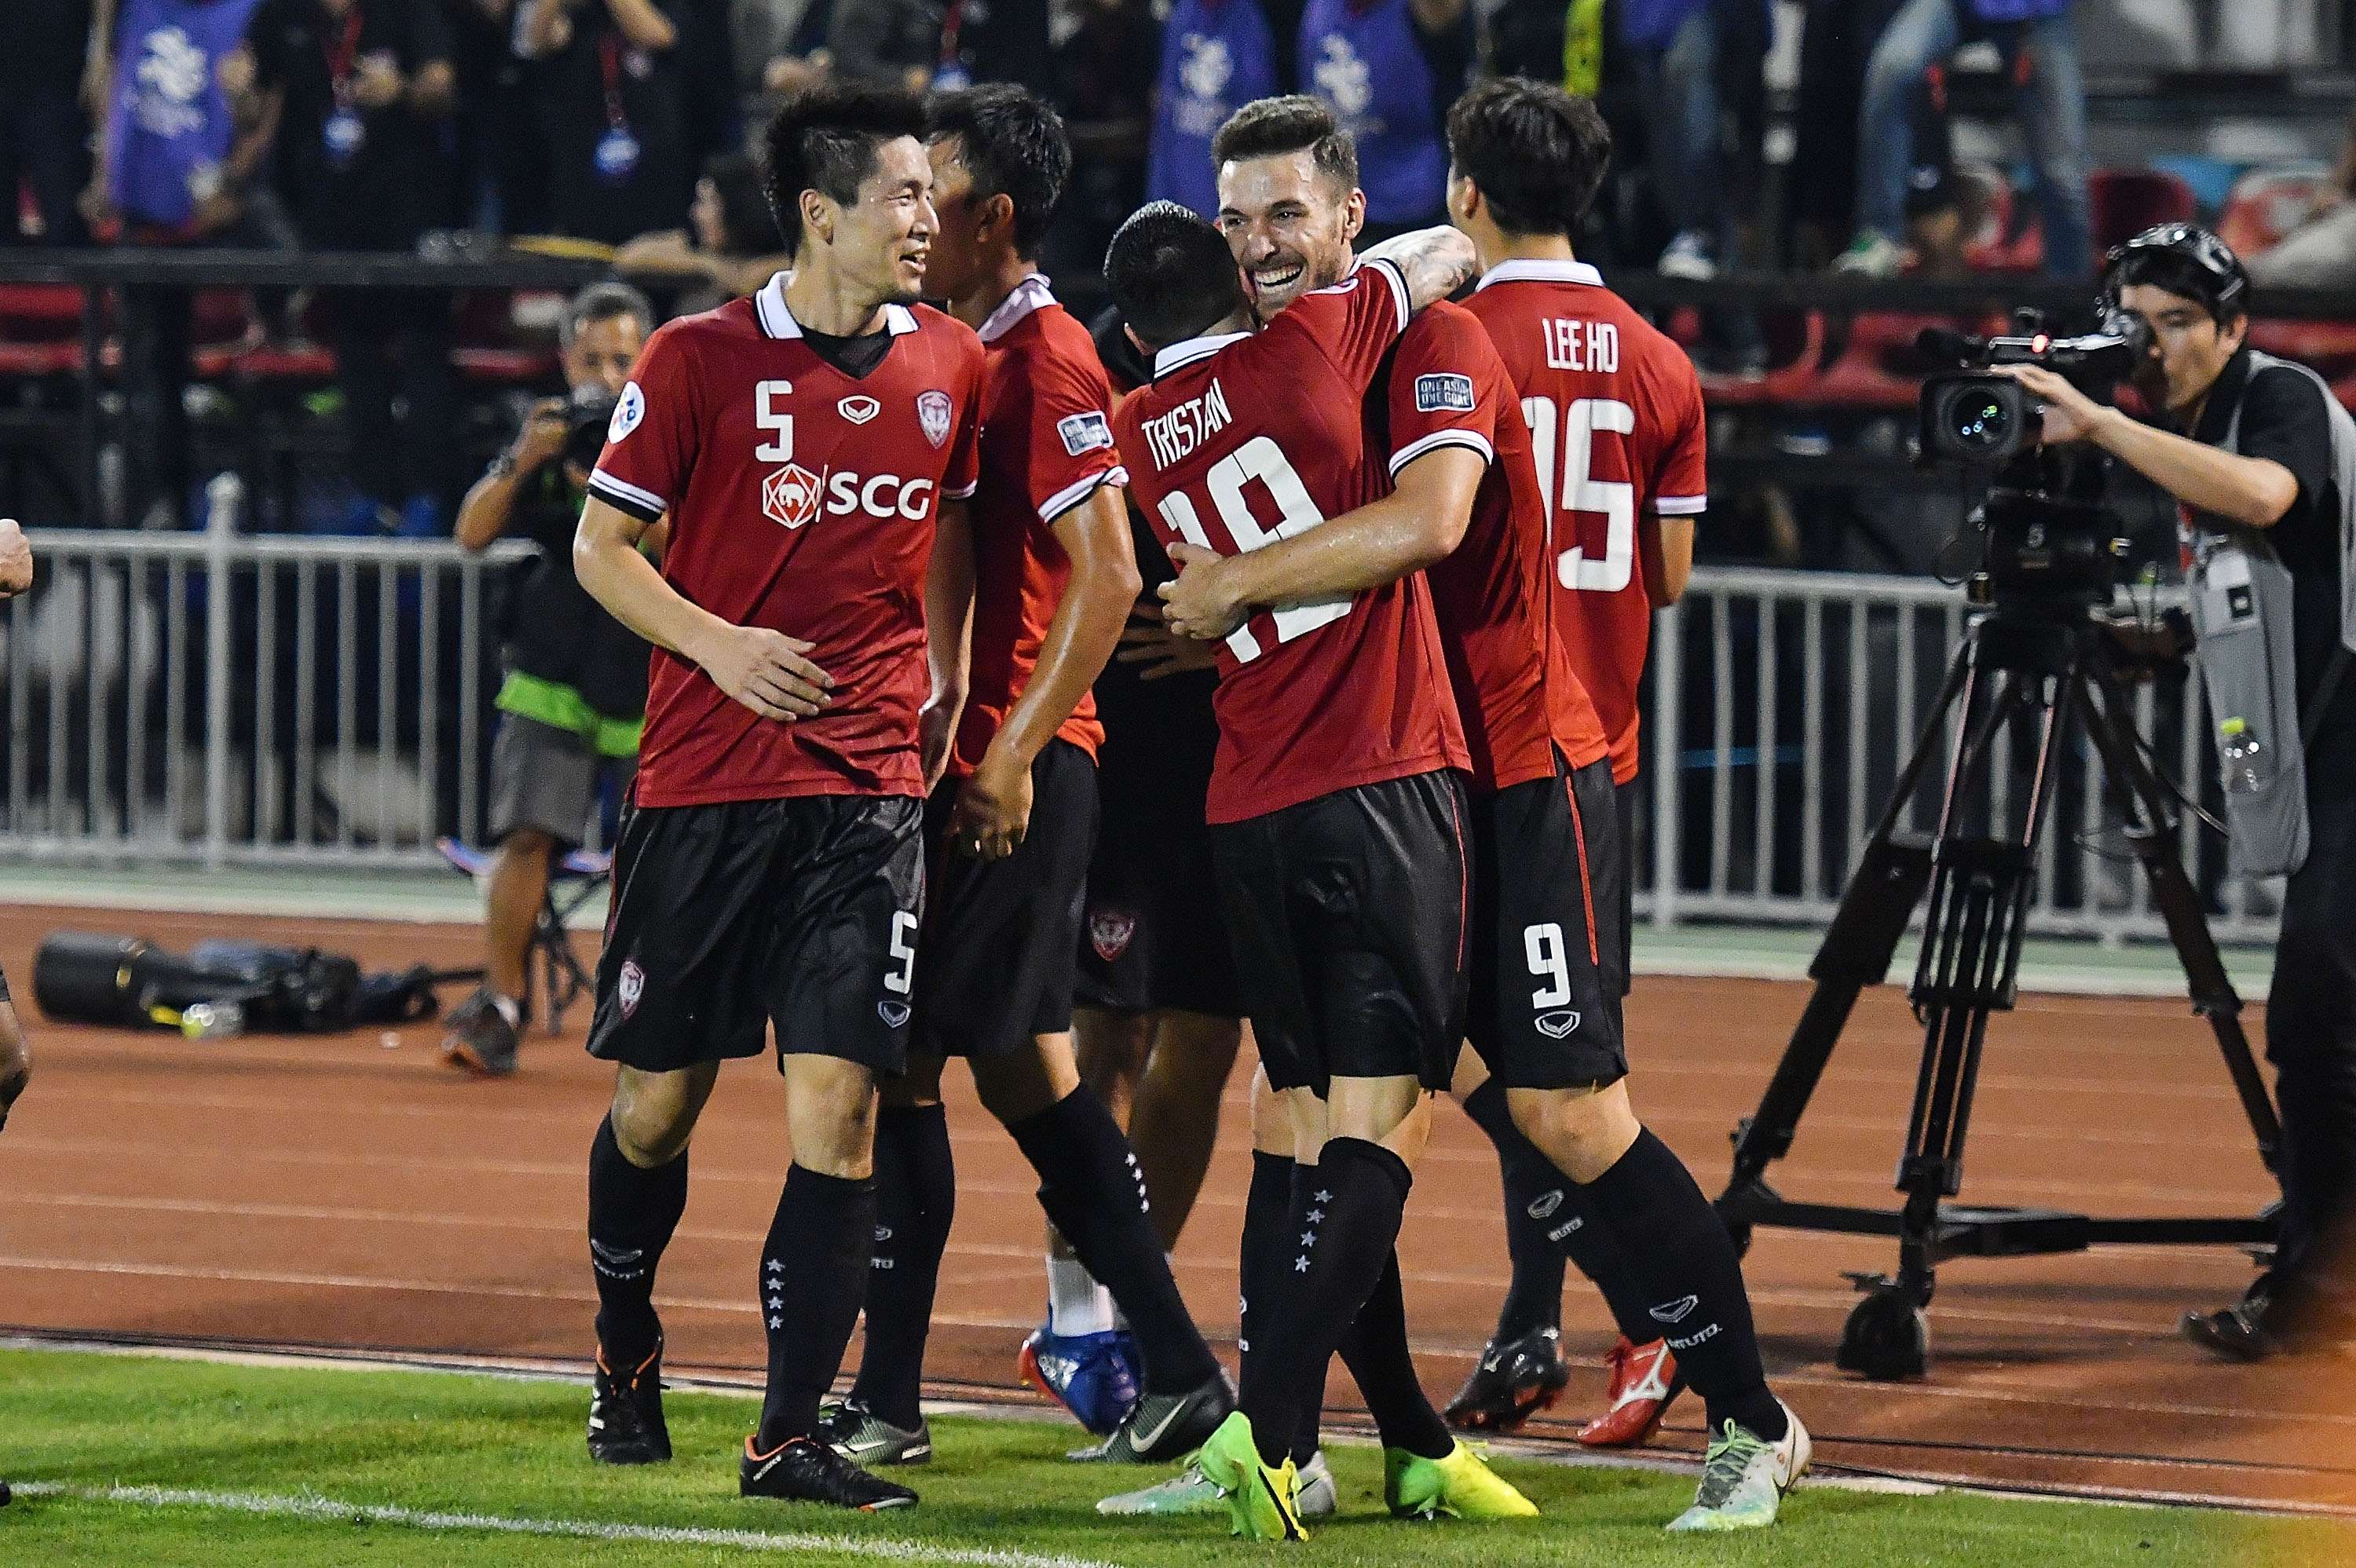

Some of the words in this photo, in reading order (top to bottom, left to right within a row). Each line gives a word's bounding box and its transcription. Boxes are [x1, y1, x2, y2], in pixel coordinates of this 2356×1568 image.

[755, 380, 793, 462] 5
[1141, 377, 1233, 471] TRISTAN
[826, 471, 933, 521] SCG
[1520, 395, 1635, 592] 15
[884, 910, 918, 994] 5
[1524, 923, 1571, 1010] 9
